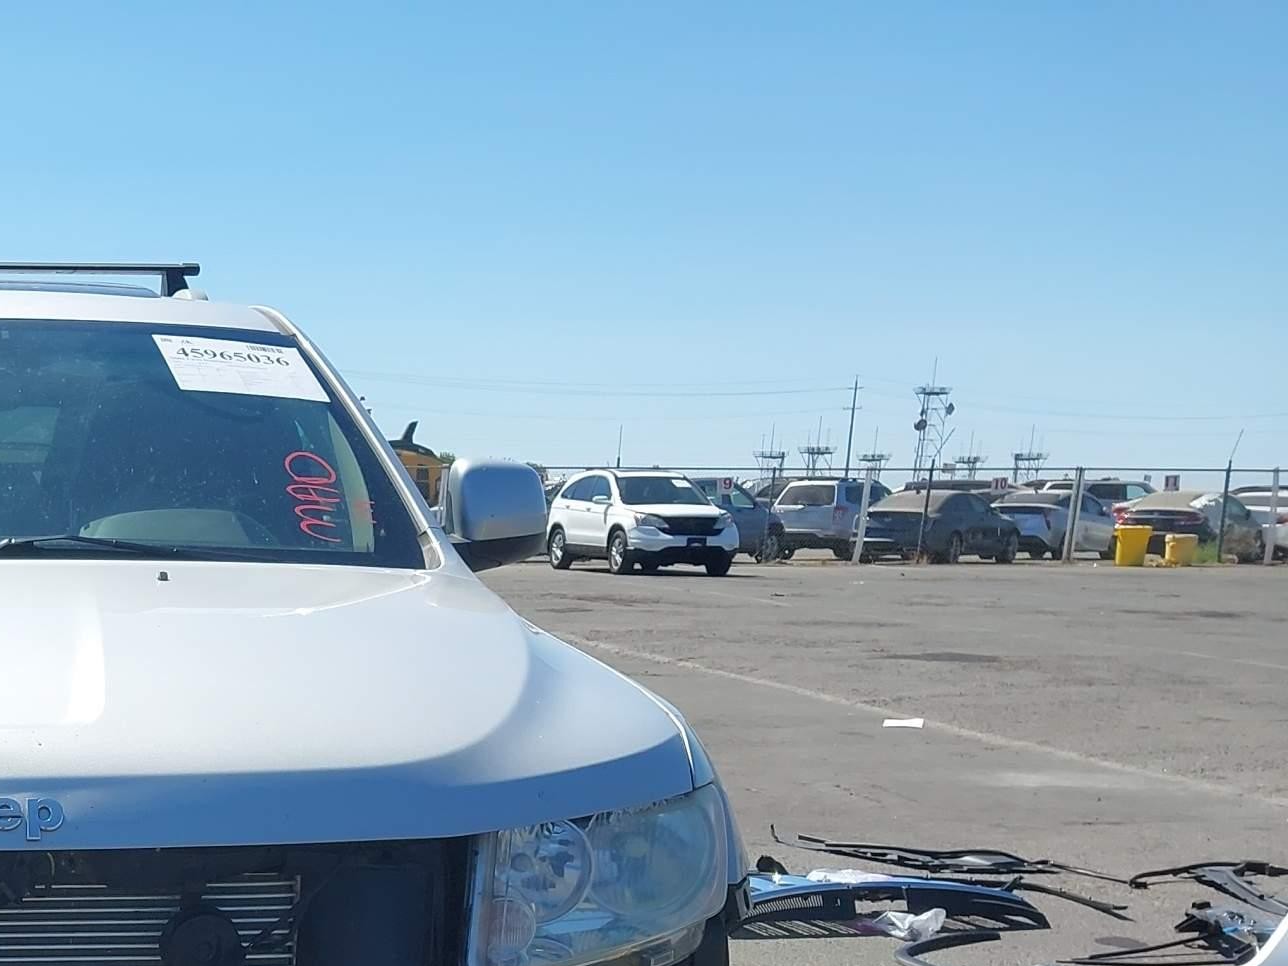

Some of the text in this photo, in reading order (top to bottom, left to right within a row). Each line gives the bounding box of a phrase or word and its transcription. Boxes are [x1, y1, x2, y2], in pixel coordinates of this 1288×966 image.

[176, 346, 291, 367] 45965036
[723, 477, 732, 489] 9
[994, 477, 1007, 489] 10
